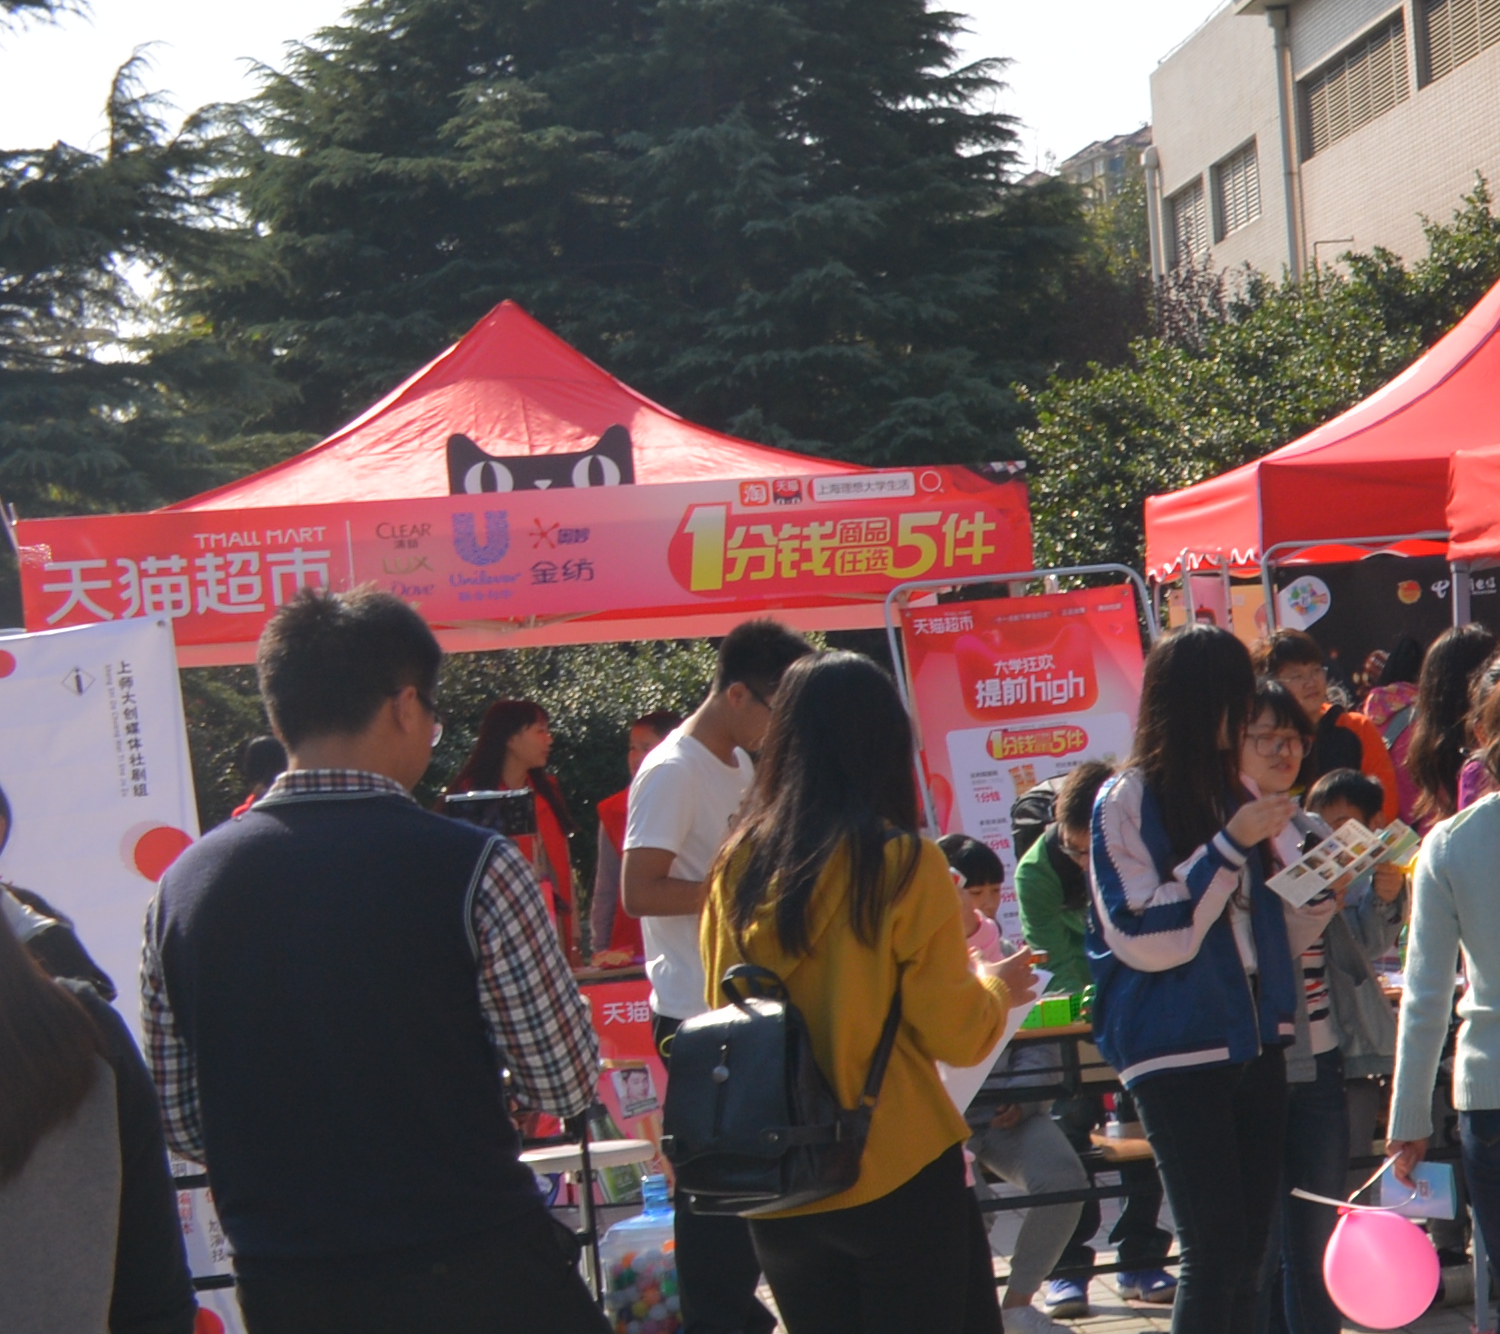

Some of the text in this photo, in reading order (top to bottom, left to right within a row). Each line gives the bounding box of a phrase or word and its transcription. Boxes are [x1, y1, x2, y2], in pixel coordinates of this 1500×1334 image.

[743, 484, 766, 504] 淘
[817, 478, 910, 496] 上海理想大学生活
[194, 526, 326, 549] TMALL MART
[376, 522, 432, 540] CLEAR
[839, 519, 888, 545] 商品
[684, 504, 837, 591] 1分钱
[887, 511, 996, 579] 5件
[530, 558, 595, 585] 金纺
[840, 548, 889, 574] 任选
[43, 548, 331, 625] 天猫超市
[913, 615, 974, 635] 天猫超市
[994, 654, 1056, 675] 大学狂欢
[975, 670, 1086, 708] 提前high
[989, 729, 1036, 759] 1分钱
[1050, 727, 1085, 754] 5件
[602, 999, 650, 1026] 天猫
